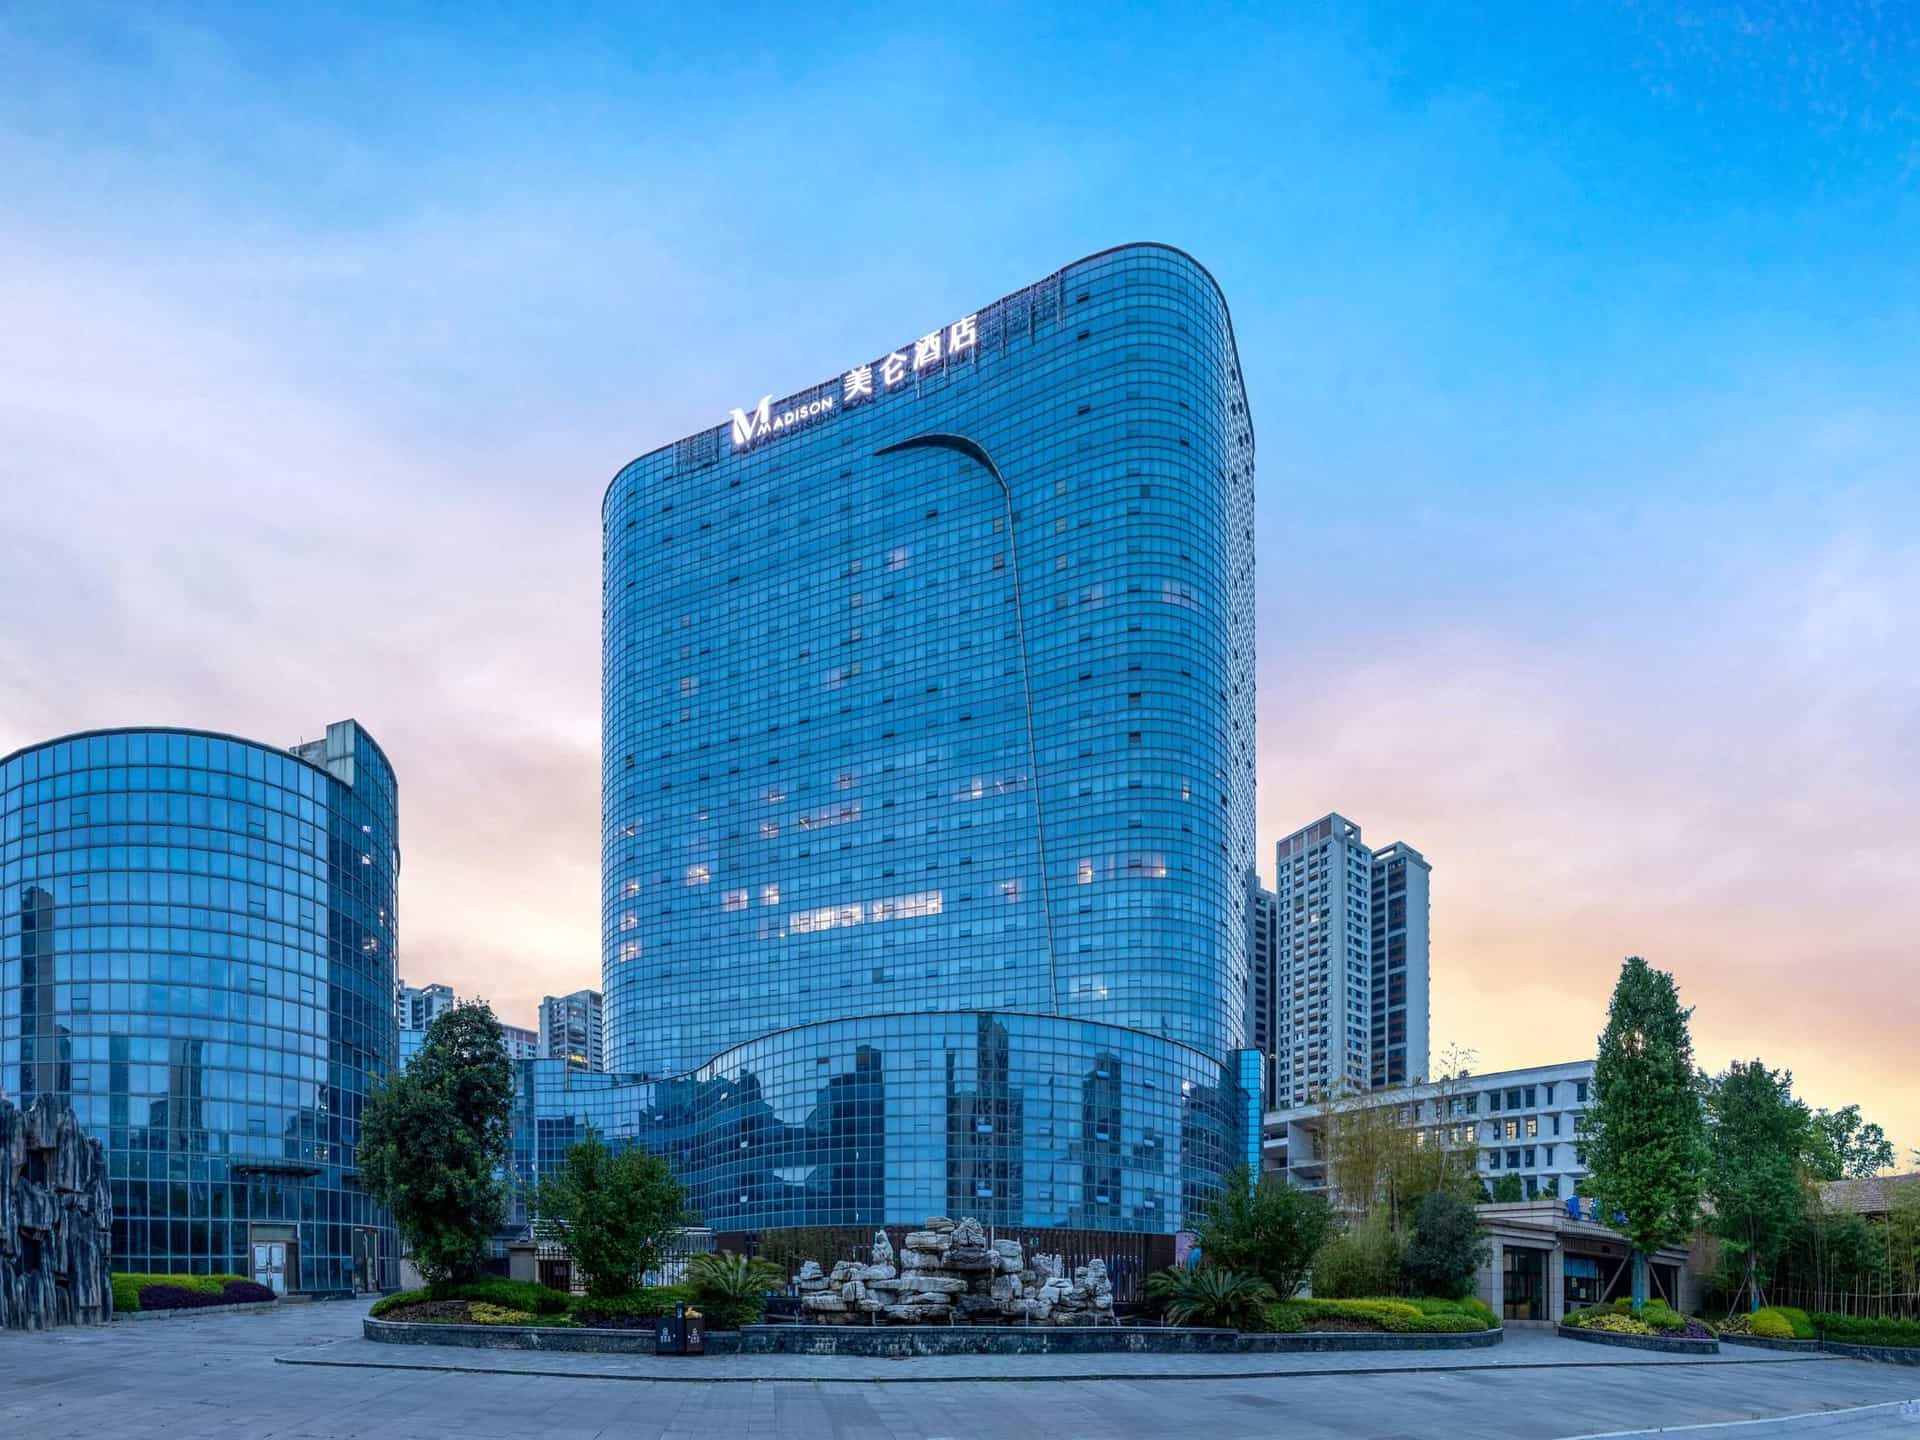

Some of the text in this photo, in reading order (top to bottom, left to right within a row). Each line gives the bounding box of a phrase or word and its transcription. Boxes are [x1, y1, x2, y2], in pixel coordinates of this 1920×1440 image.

[843, 314, 978, 401] 美仑酒店
[757, 397, 833, 436] MADISON
